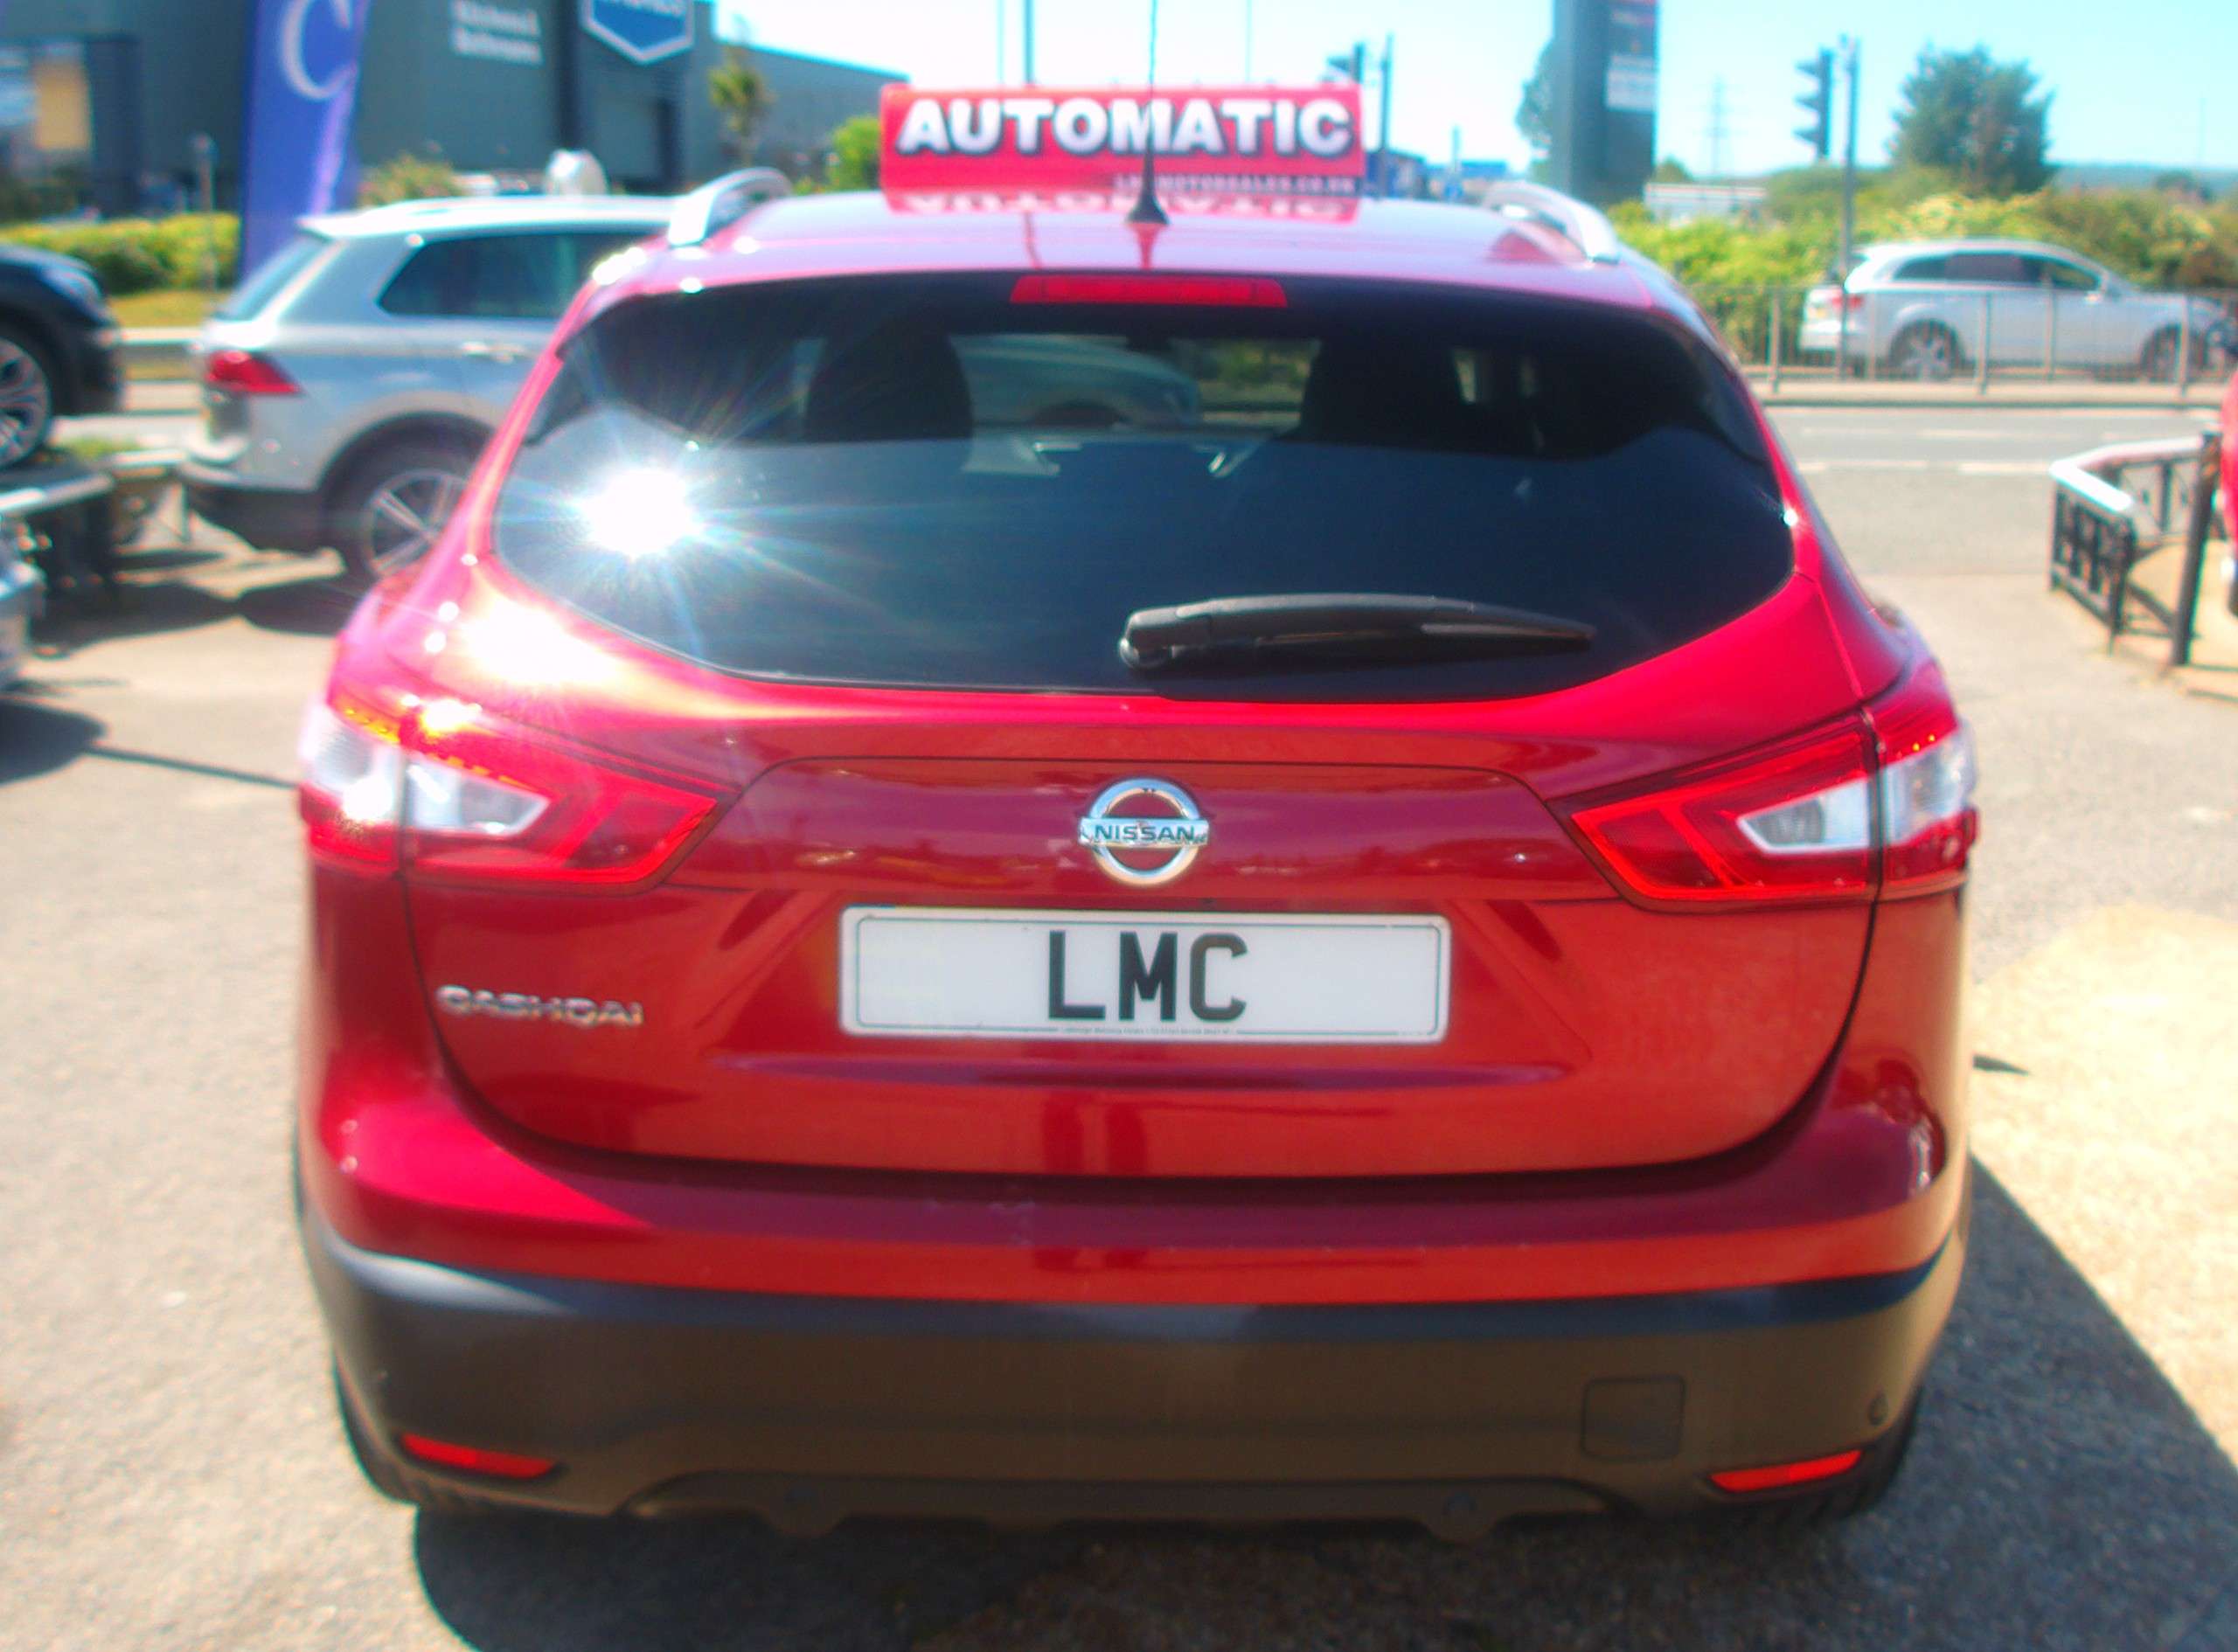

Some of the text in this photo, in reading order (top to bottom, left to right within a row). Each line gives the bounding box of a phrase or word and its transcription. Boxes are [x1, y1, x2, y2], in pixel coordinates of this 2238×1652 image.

[897, 98, 1353, 156] AUTOMATIC
[1095, 824, 1195, 842] NISSAN
[1048, 930, 1248, 1023] LMC
